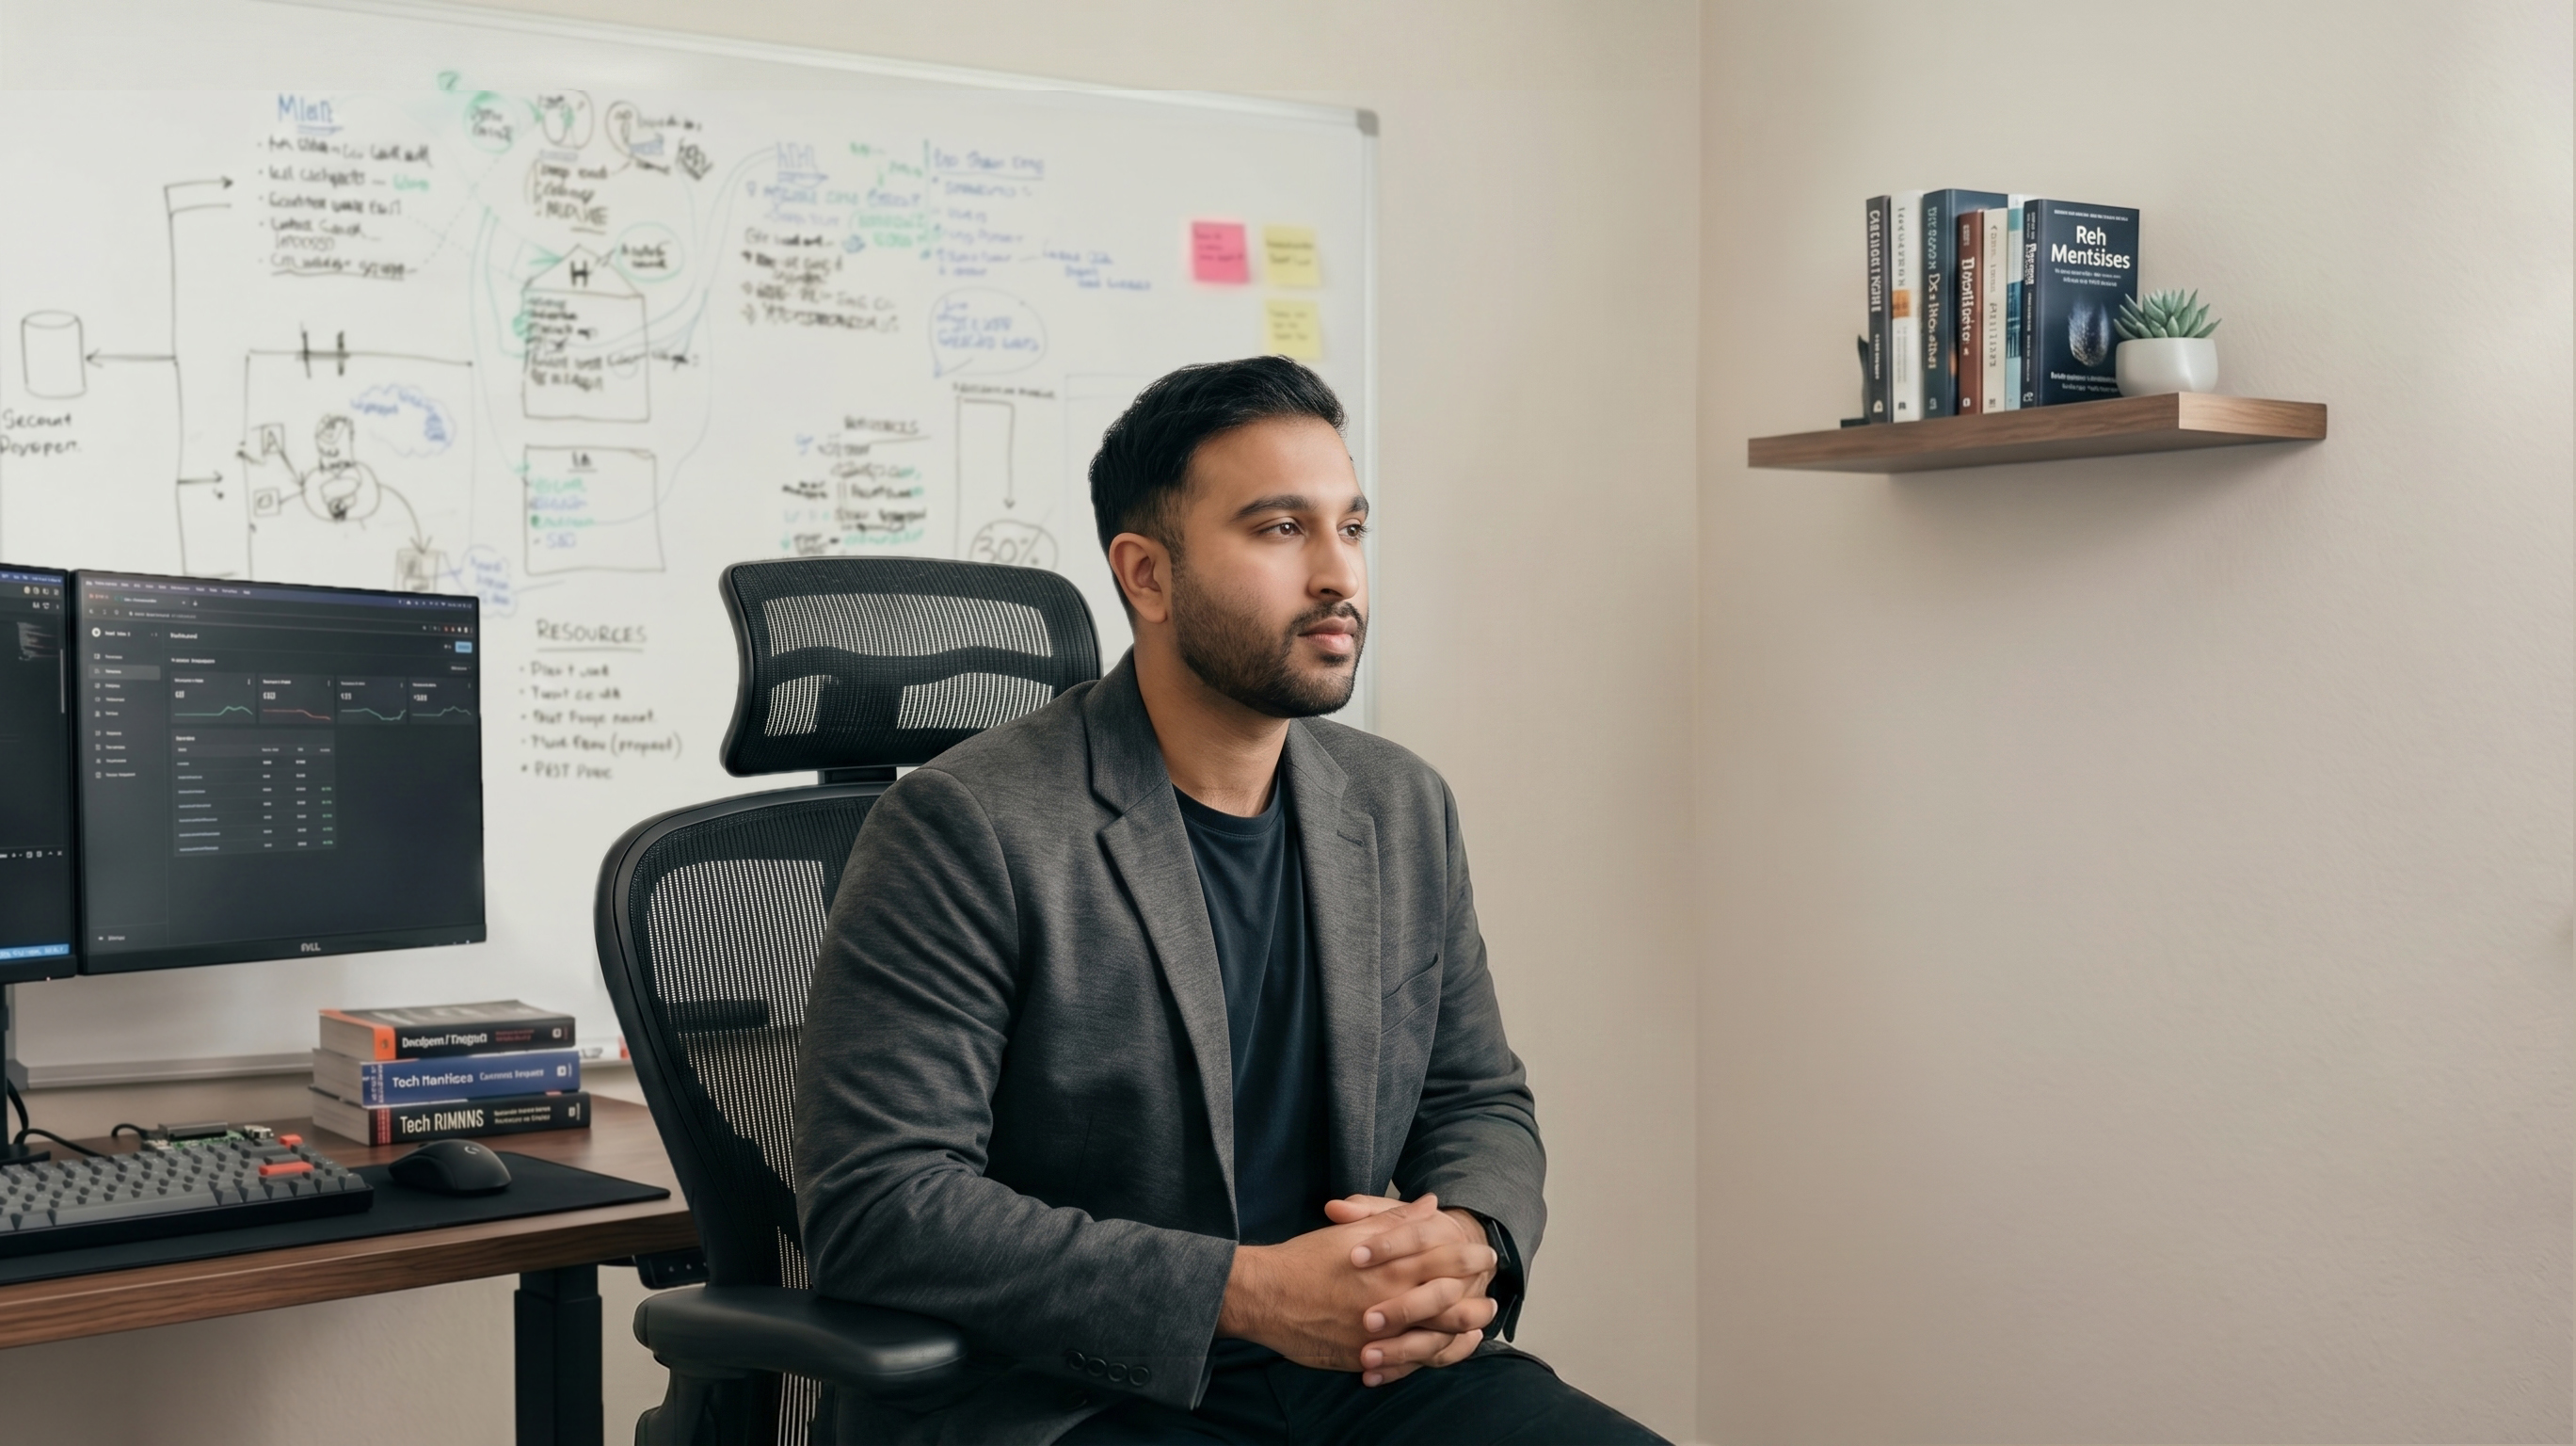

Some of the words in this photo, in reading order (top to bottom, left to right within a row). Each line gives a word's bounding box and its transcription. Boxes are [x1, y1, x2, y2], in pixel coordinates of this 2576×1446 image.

[2076, 225, 2106, 246] Reh
[536, 619, 648, 644] RESOURCES
[399, 1114, 431, 1134] Tech
[434, 1109, 485, 1131] RIMNNS
